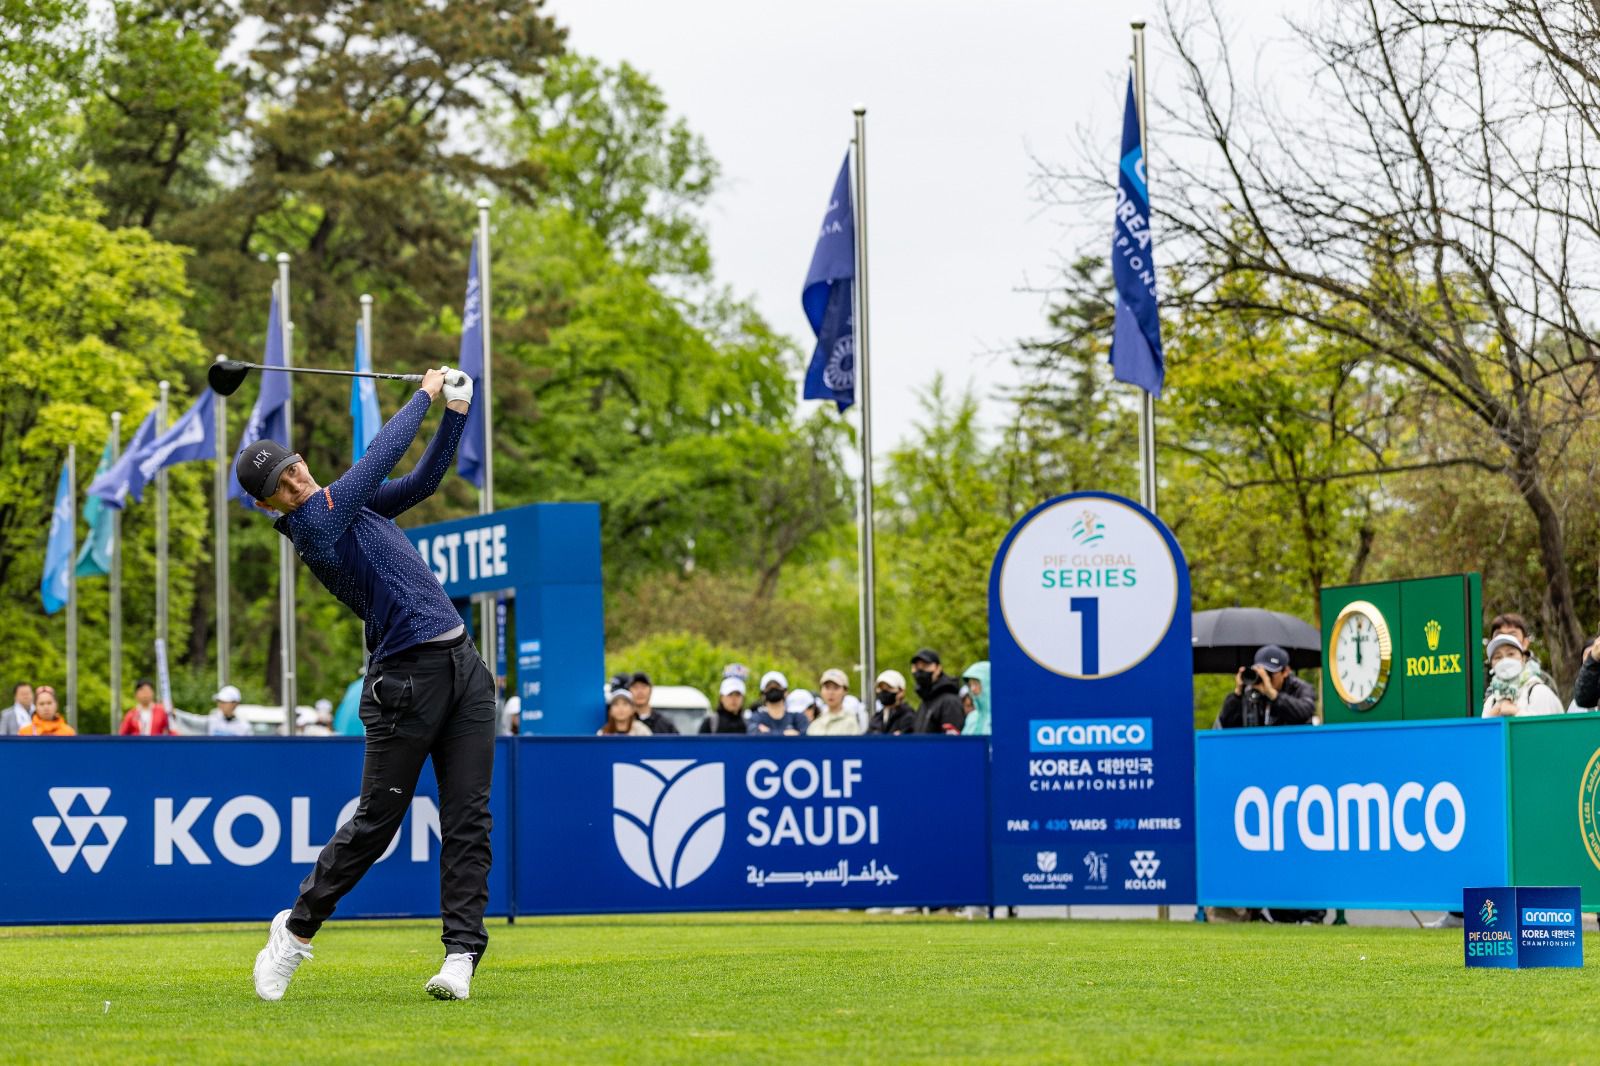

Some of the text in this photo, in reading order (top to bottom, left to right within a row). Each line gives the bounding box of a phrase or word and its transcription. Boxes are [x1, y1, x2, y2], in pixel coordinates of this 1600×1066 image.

[252, 449, 272, 469] ACK
[464, 524, 508, 580] TEE
[1043, 553, 1136, 568] PIF GLOBAL
[1041, 568, 1137, 589] SERIES
[1070, 596, 1099, 676] 1
[1406, 653, 1462, 677] ROLEX
[1036, 724, 1146, 746] aramco
[1029, 757, 1154, 777] KOREA 대한민국
[745, 758, 863, 800] GOLF
[1029, 778, 1155, 792] CHAMPIONSHIP
[746, 805, 879, 847] SAUDI
[1007, 819, 1029, 831] PAR
[1045, 819, 1068, 831] 430
[1069, 818, 1108, 831] YARDS
[1138, 817, 1181, 830] METRES
[1234, 780, 1467, 852] aramco
[1124, 879, 1166, 890] KOLON
[1525, 911, 1572, 923] aramco
[1468, 930, 1513, 942] PIF GLOBAL
[1521, 929, 1576, 939] KOREA 대한민국
[1468, 941, 1514, 957] SERIES
